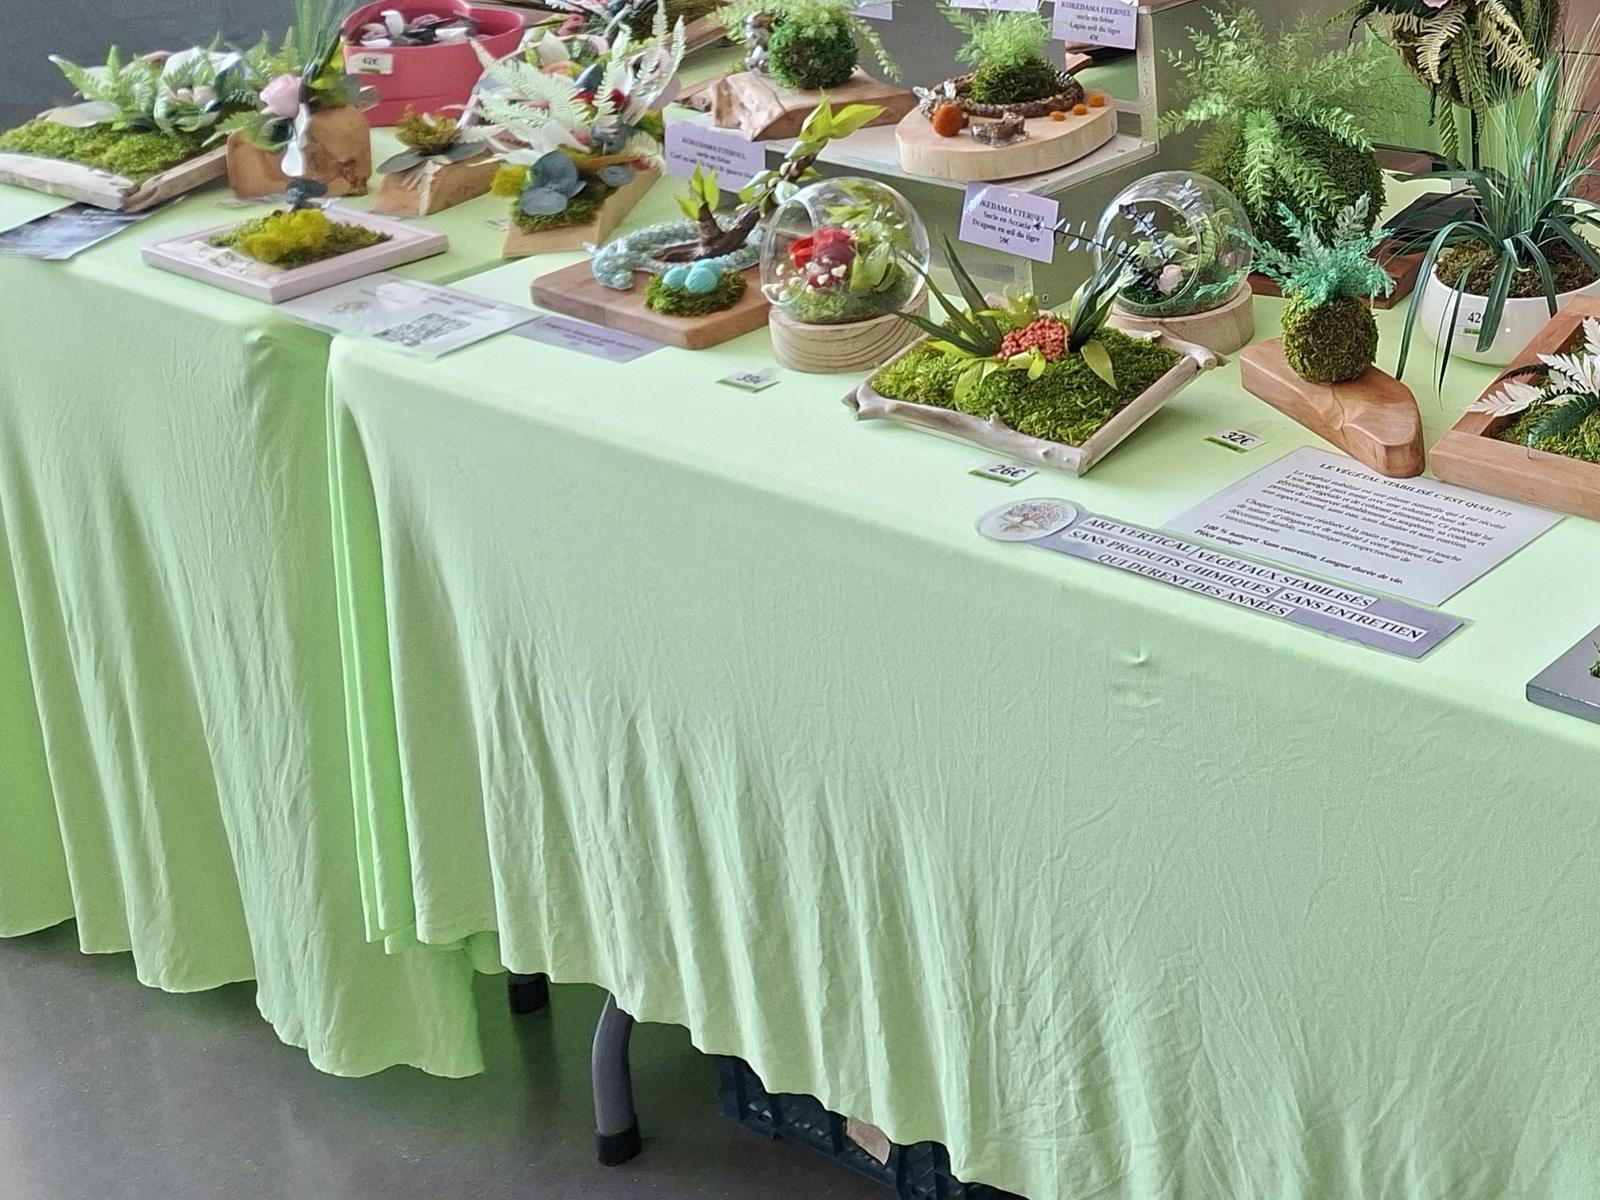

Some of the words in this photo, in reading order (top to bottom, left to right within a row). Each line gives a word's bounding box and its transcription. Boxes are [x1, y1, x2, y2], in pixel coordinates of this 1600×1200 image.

[988, 464, 1026, 478] 26€
[1335, 467, 1379, 482] VÉGÉTAL
[1380, 480, 1433, 496] STABILISÉ
[1465, 501, 1493, 512] QUOI
[1084, 519, 1120, 530] ART
[1119, 527, 1190, 552] VERTICAL
[1068, 531, 1108, 544] SANS
[1106, 540, 1183, 567] PRODUITS
[1183, 564, 1273, 593] CHIMIQUES
[1097, 553, 1128, 568] QUI
[1123, 562, 1193, 585] DURENT
[1189, 581, 1224, 595] DES
[1221, 592, 1288, 614] ANNÉES
[1198, 551, 1280, 579] VÉGÉTAUX
[1279, 576, 1371, 606] STABILISÉS
[1280, 592, 1324, 609] SANS
[1323, 605, 1422, 638] ENTRETIEN
